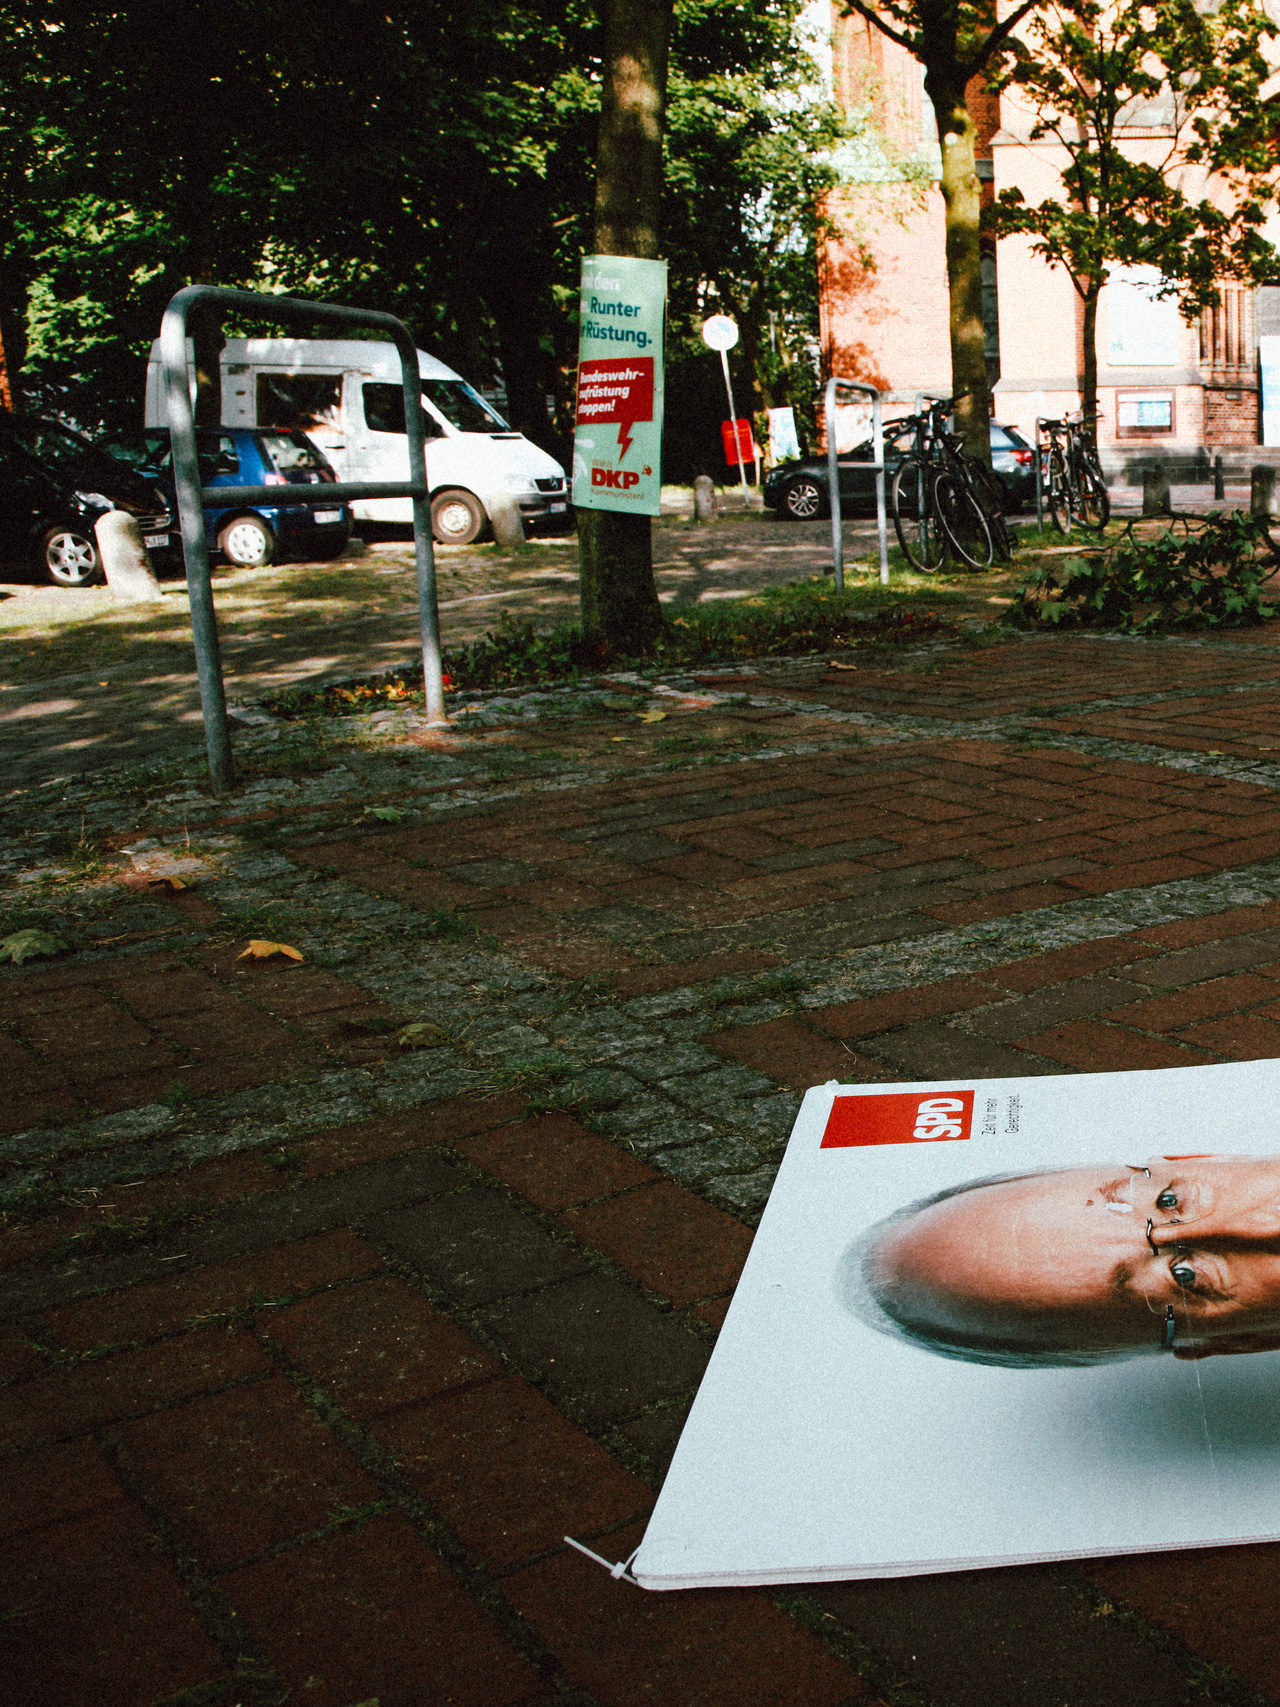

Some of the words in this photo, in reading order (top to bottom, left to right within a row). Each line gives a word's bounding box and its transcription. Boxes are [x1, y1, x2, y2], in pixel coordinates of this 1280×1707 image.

[590, 296, 641, 317] Runter
[586, 320, 652, 348] Rüstung.
[591, 468, 640, 489] DKP
[984, 1098, 998, 1112] mehr
[912, 1097, 964, 1139] SPD
[983, 1113, 996, 1122] für
[981, 1123, 996, 1135] Zeit
